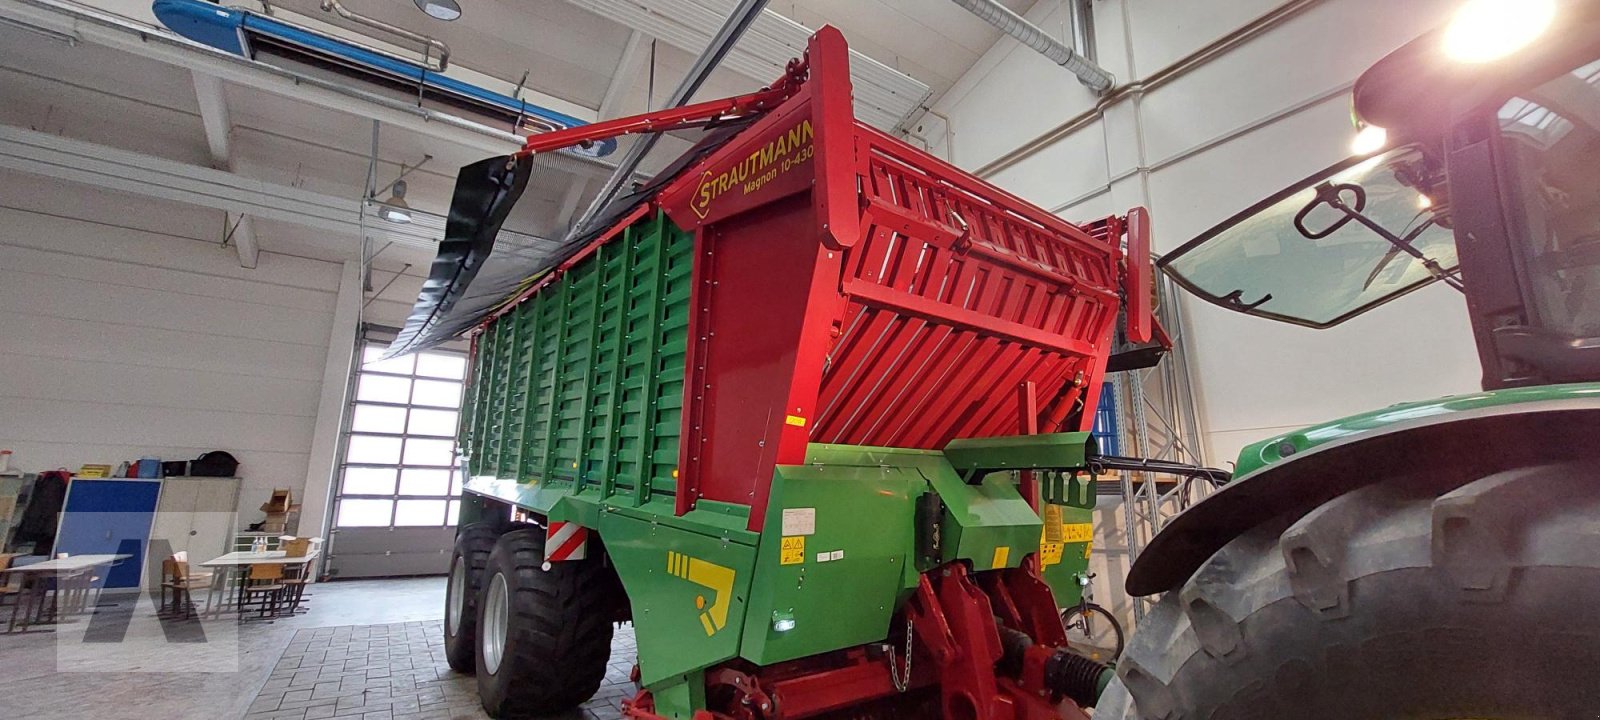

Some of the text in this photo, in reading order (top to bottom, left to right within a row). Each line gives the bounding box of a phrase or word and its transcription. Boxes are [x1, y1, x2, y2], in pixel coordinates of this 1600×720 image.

[699, 120, 813, 208] STRAUTMANN
[743, 145, 814, 195] Magnon 10-430
